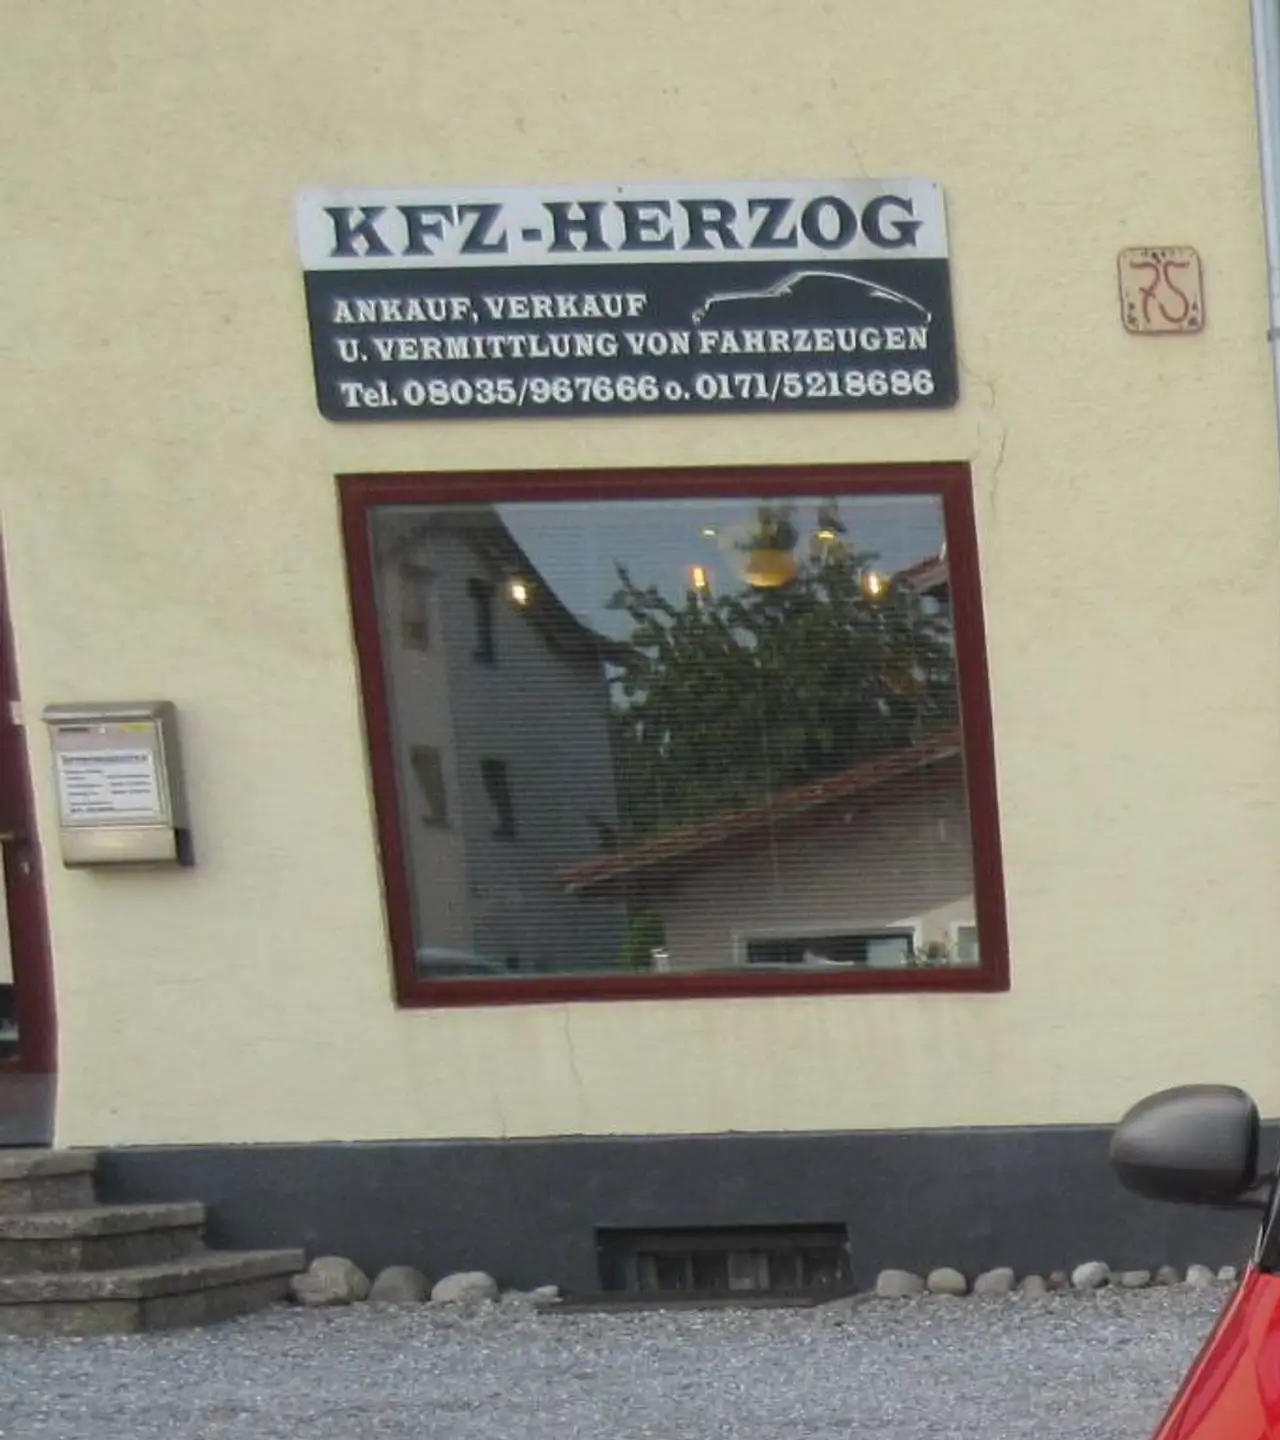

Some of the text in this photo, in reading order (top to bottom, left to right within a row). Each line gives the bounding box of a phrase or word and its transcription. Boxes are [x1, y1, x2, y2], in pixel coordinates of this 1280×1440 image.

[322, 194, 925, 258] KFZ-HERZOG
[332, 292, 648, 325] ANKAUF, VERKAUF
[336, 325, 929, 363] U. VERMITTLUNG VON FAHRZEUGEN
[340, 379, 398, 409] Tel.
[401, 374, 660, 407] 08035/967666
[694, 368, 936, 402] 0171/5218686
